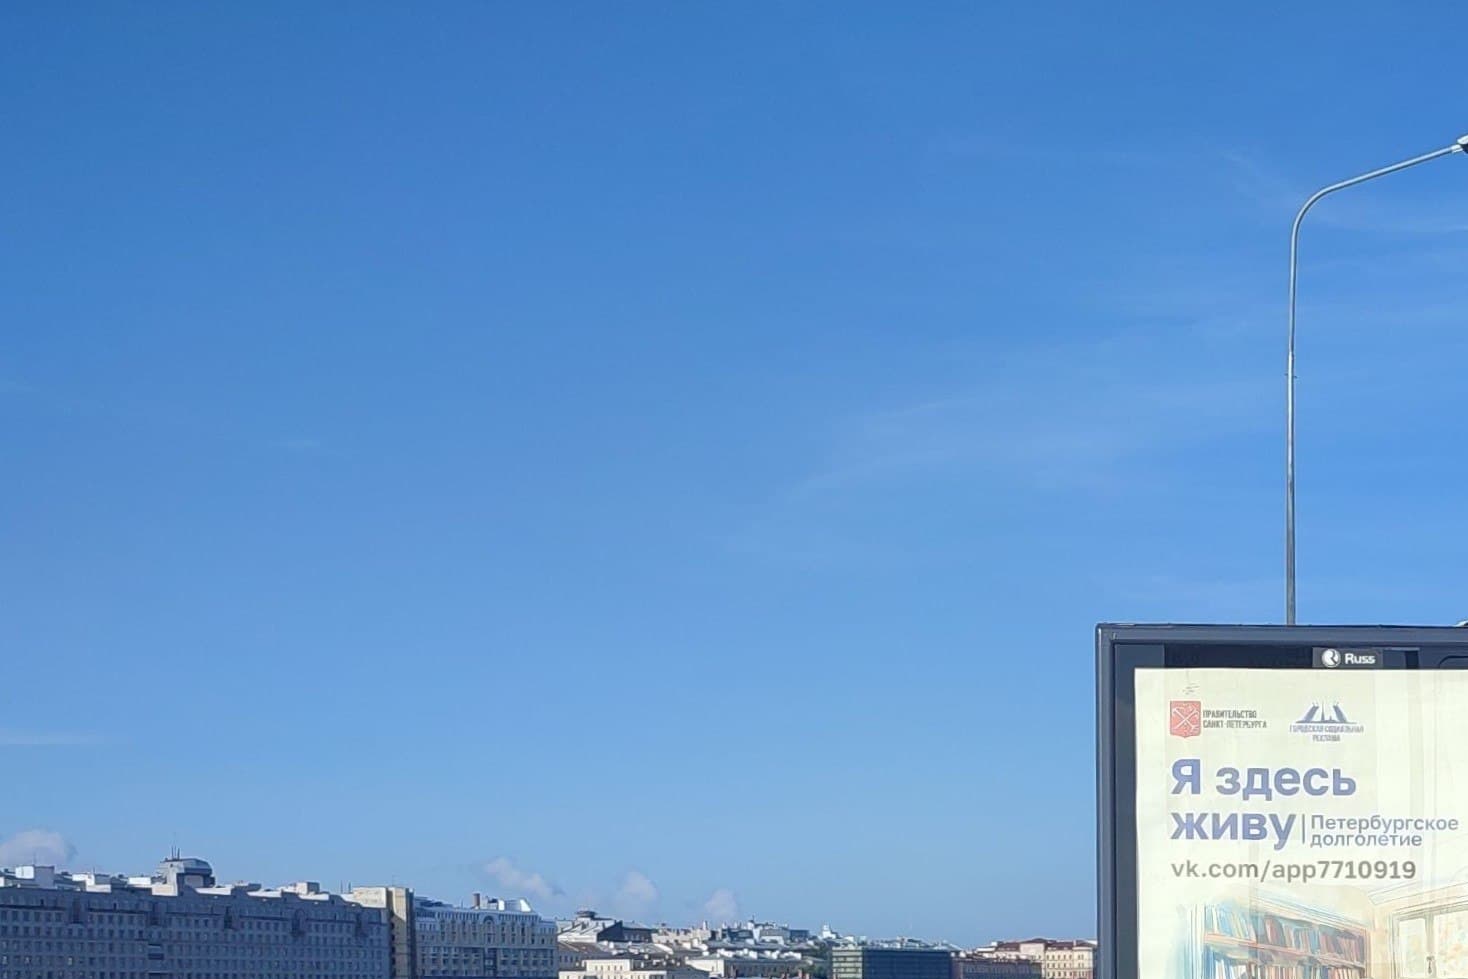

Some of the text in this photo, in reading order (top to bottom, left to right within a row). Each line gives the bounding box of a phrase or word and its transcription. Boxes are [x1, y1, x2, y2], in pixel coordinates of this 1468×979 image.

[1344, 652, 1376, 665] Russ
[1171, 758, 1357, 801] Я здесь
[1170, 812, 1296, 850] живу
[1310, 813, 1459, 834] Петербургское
[1310, 831, 1423, 848] долголетие
[1171, 859, 1417, 883] vk.com/app7710919
